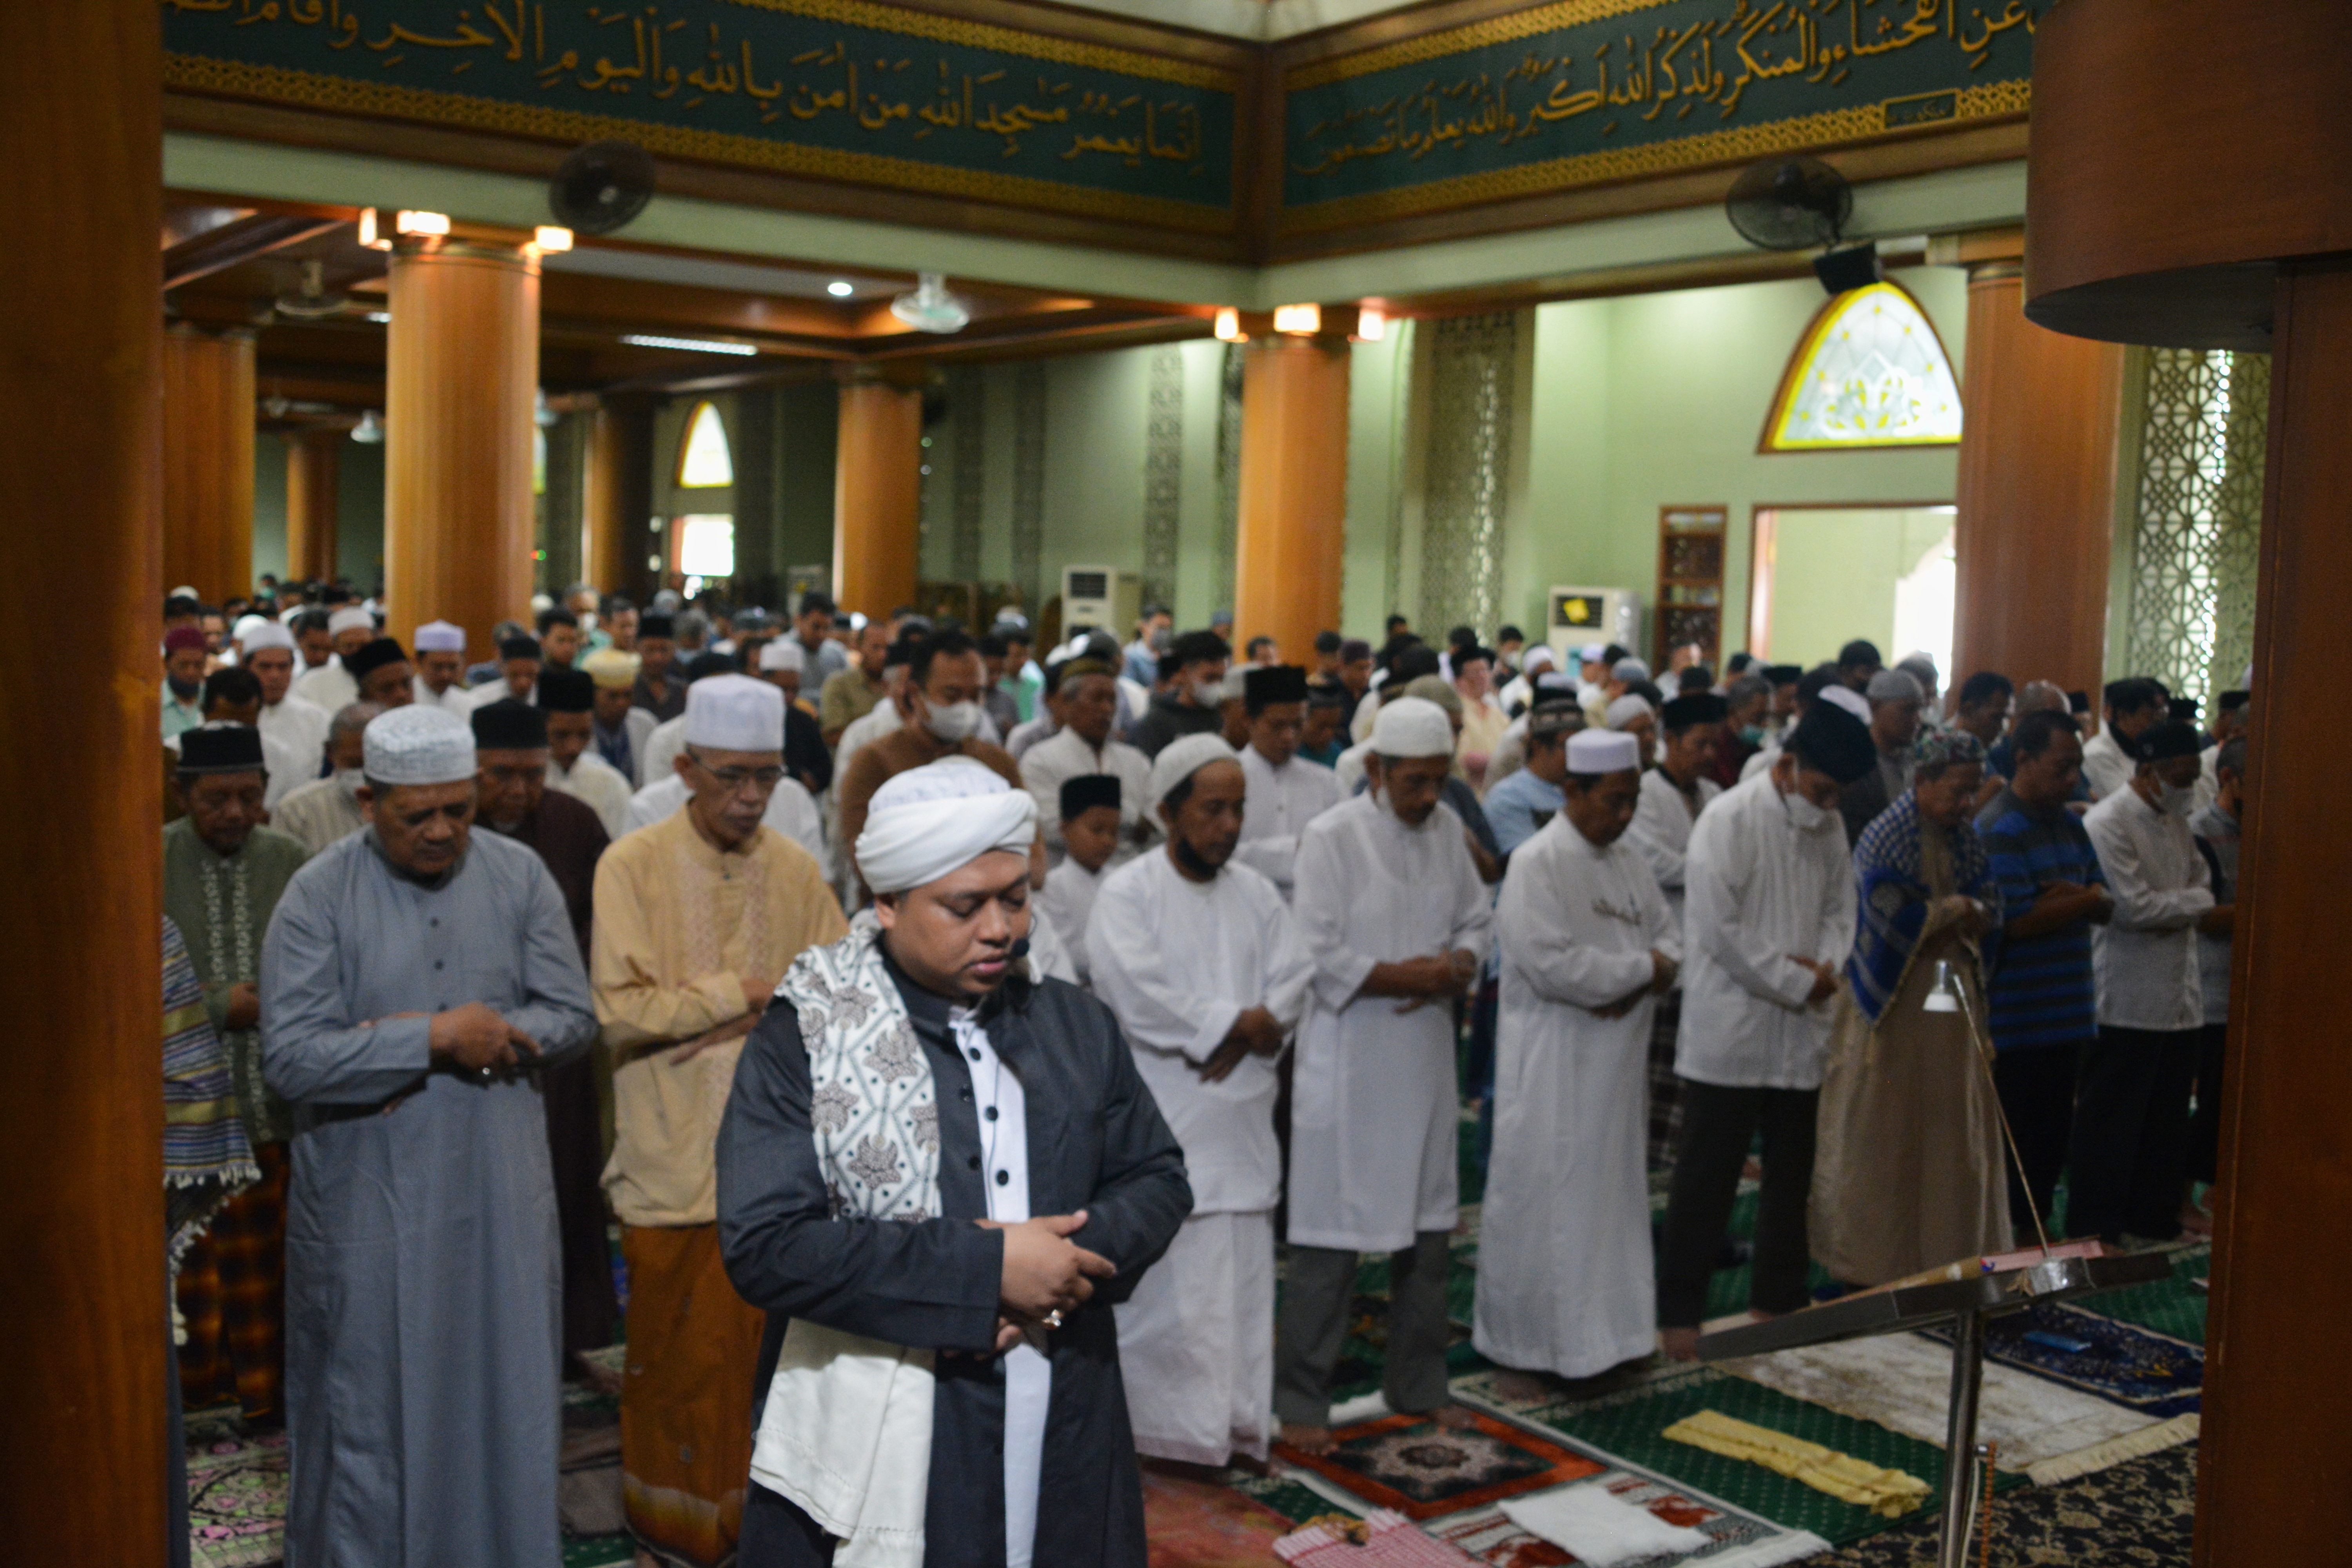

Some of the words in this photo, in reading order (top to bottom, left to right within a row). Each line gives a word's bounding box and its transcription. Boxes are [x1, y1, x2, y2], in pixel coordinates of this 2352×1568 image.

[684, 23, 782, 125] بالله
[858, 58, 913, 129] من
[913, 58, 972, 140] الله
[1602, 33, 1653, 135] الله
